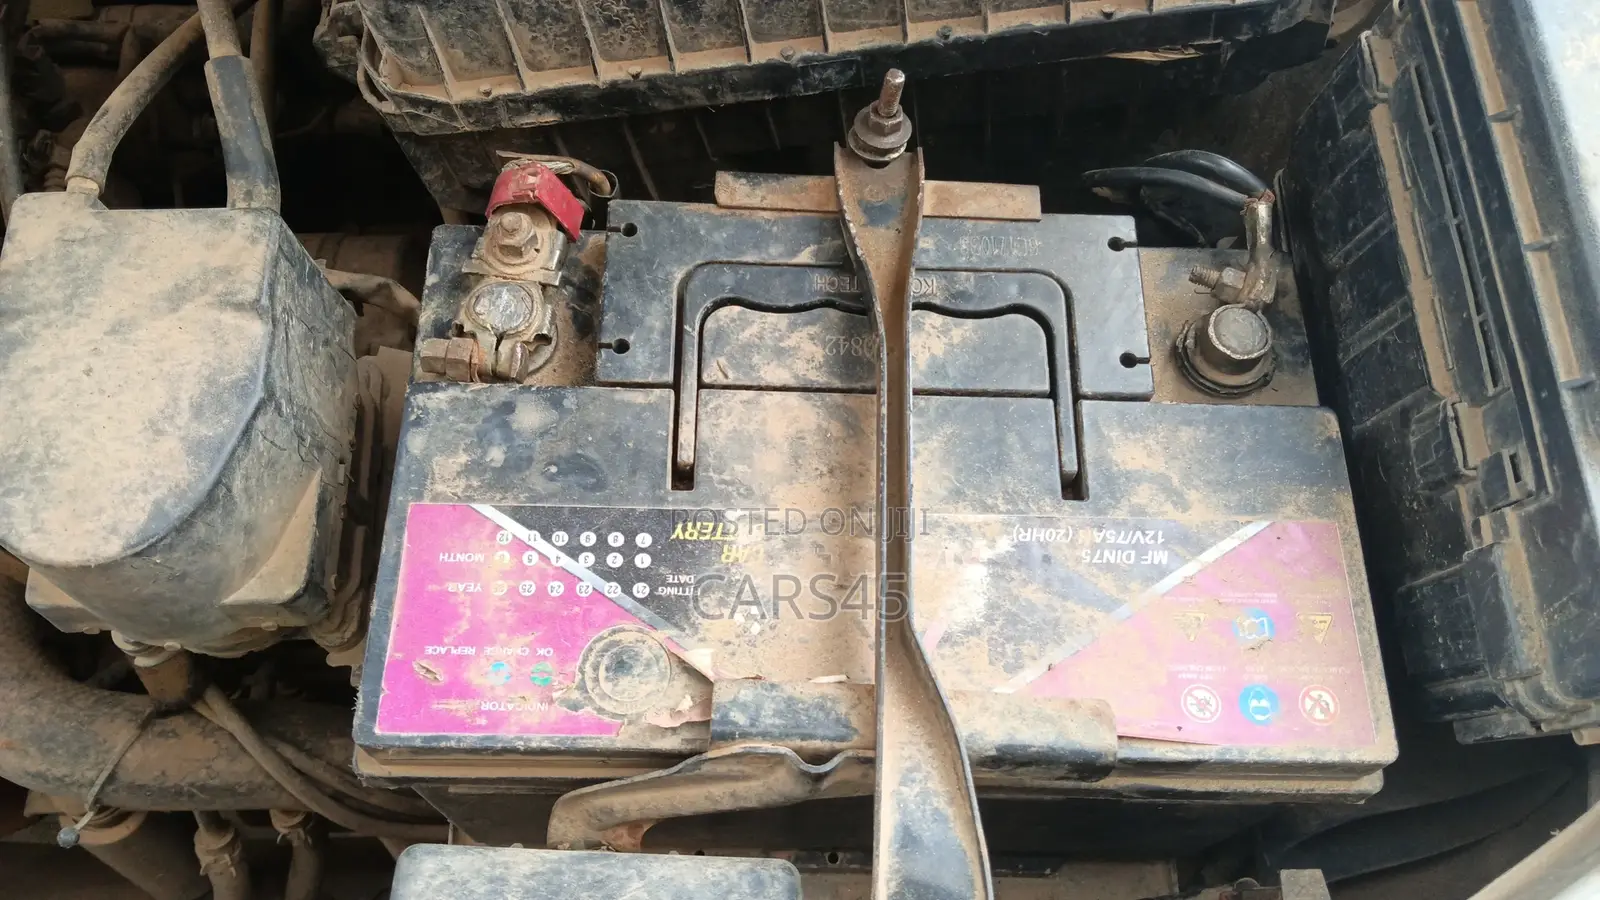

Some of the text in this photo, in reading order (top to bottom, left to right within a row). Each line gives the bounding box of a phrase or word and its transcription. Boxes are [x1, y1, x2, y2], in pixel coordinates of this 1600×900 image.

[1012, 524, 1073, 543] (20HR)
[439, 552, 485, 562] MONTH
[1082, 549, 1168, 565] MF DIN75
[665, 574, 695, 584] DATE
[447, 582, 483, 593] YEAR
[424, 645, 476, 655] REPLACE
[535, 647, 554, 657] OK
